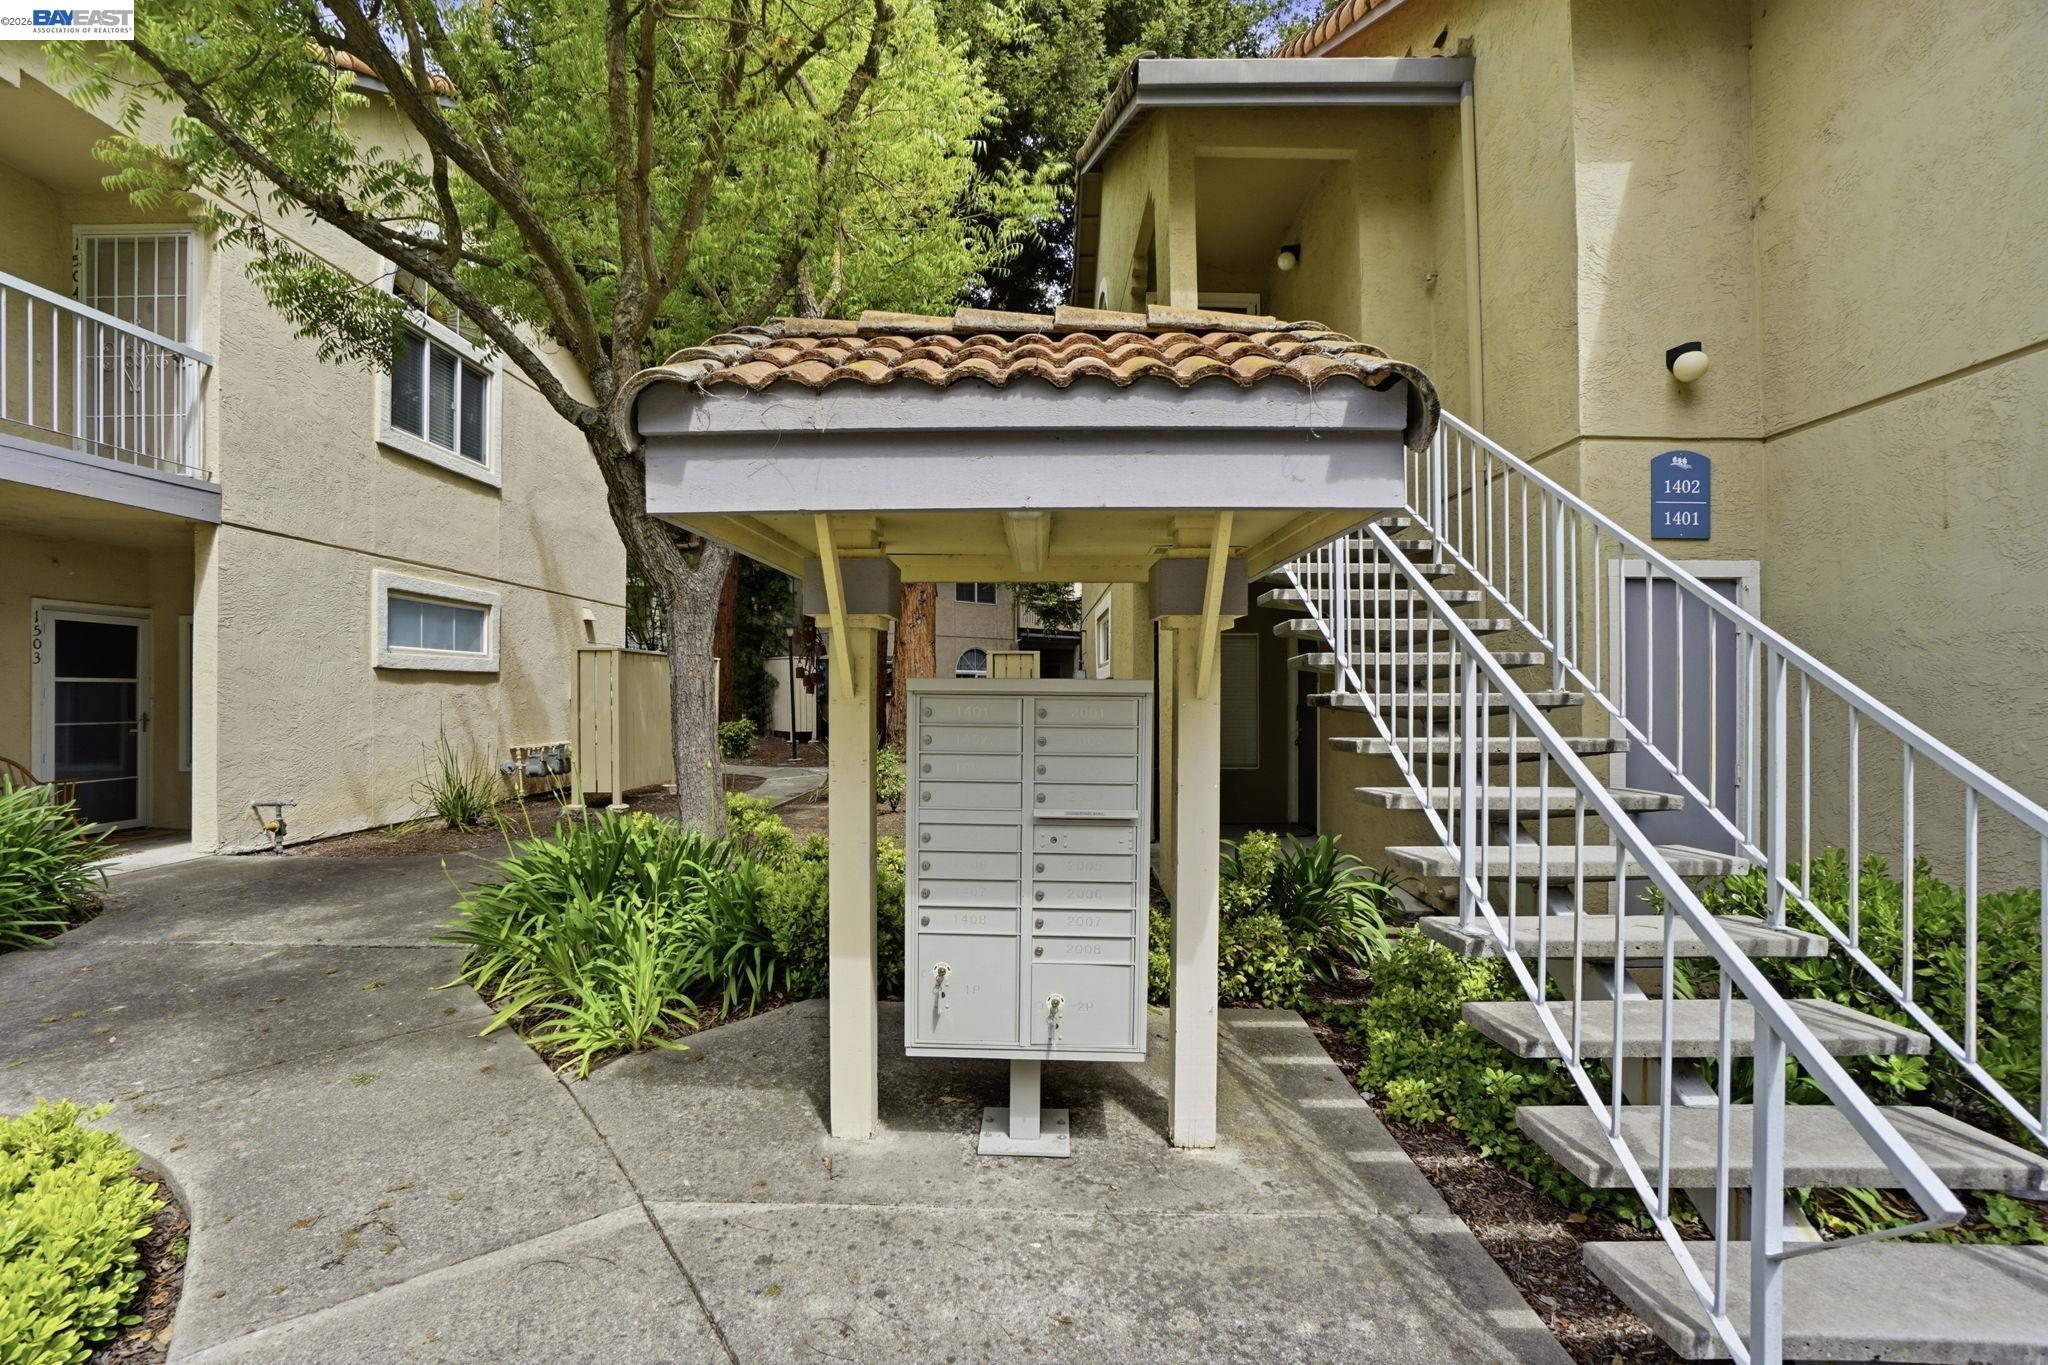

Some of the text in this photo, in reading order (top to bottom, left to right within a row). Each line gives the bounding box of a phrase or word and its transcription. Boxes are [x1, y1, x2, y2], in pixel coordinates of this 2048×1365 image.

[1664, 480, 1700, 494] 1402
[1664, 511, 1700, 526] 1401
[32, 610, 42, 665] 1503
[1071, 707, 1104, 720] 2001
[1066, 888, 1102, 899] 2006
[953, 914, 987, 925] 1408
[1066, 916, 1102, 927] 2007
[1066, 943, 1101, 954] 2008
[965, 984, 981, 994] 1P
[1077, 1003, 1094, 1012] 2P
